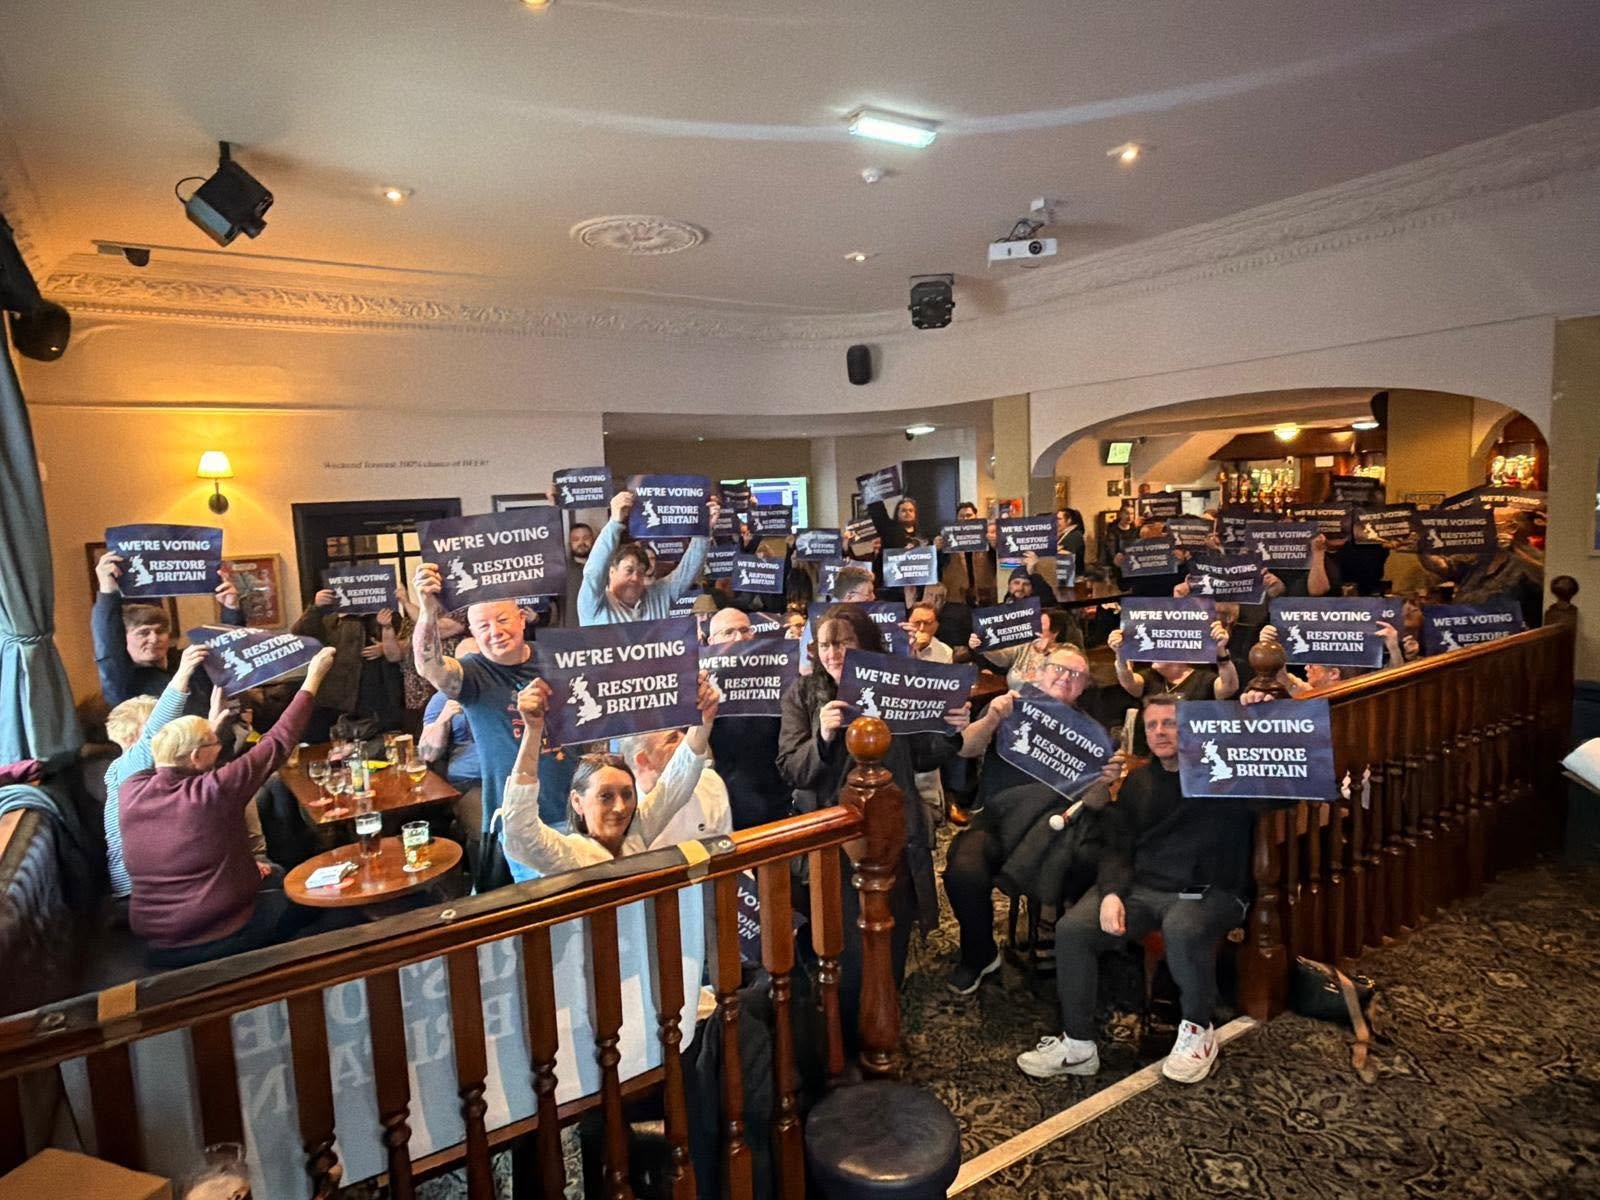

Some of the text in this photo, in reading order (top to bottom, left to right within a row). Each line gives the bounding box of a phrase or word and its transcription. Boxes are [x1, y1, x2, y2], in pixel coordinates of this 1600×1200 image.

[636, 487, 704, 498] WE'RE VOTING
[657, 505, 699, 514] RESTORE
[662, 515, 698, 524] BRITAIN
[1001, 524, 1052, 533] WE'RE VOTING
[118, 540, 210, 550] WE'RE VOTING
[433, 526, 550, 554] WE'RE VOTING
[1016, 536, 1048, 544] RESTORE
[149, 560, 206, 571] RESTORE
[472, 554, 544, 574] RESTORE
[156, 570, 206, 582] BRITAIN
[328, 574, 390, 584] WE'RE VOTING
[481, 568, 544, 586] BRITAIN
[347, 588, 386, 597] RESTORE
[352, 596, 387, 604] BRITAIN
[979, 608, 1034, 626] WE'RE VOTING
[1129, 610, 1208, 622] WE'RE VOTING
[1280, 611, 1318, 622] WE'RE
[1320, 611, 1371, 622] VOTING
[1434, 614, 1512, 627] WE'RE VOTING
[750, 622, 780, 634] OTING
[997, 622, 1032, 636] RESTORE
[1151, 629, 1202, 639] RESTORE
[204, 628, 248, 649] WE'RE
[1001, 630, 1034, 642] BRITAIN
[1306, 630, 1364, 641] RESTORE
[1156, 640, 1202, 650] BRITAIN
[1312, 642, 1364, 652] BRITAIN
[252, 640, 304, 668] BRITAIN
[554, 640, 686, 668] WE'RE VOTING
[699, 654, 788, 668] WE'RE VOTING
[724, 676, 781, 689] RESTORE
[855, 666, 960, 691] WE'RE VOTING
[598, 674, 678, 698] RESTORE
[730, 689, 780, 701] BRITAIN
[606, 692, 678, 714] BRITAIN
[880, 696, 946, 710] RESTORE
[884, 710, 943, 720] BRITAIN
[1022, 702, 1105, 758] WE'RE VOTING
[1190, 720, 1314, 734] WE'RE VOTING
[1032, 734, 1087, 772] RESTORE
[1226, 748, 1307, 762] RESTORE
[1030, 746, 1081, 782] BRITAIN
[1236, 764, 1308, 778] BRITAIN
